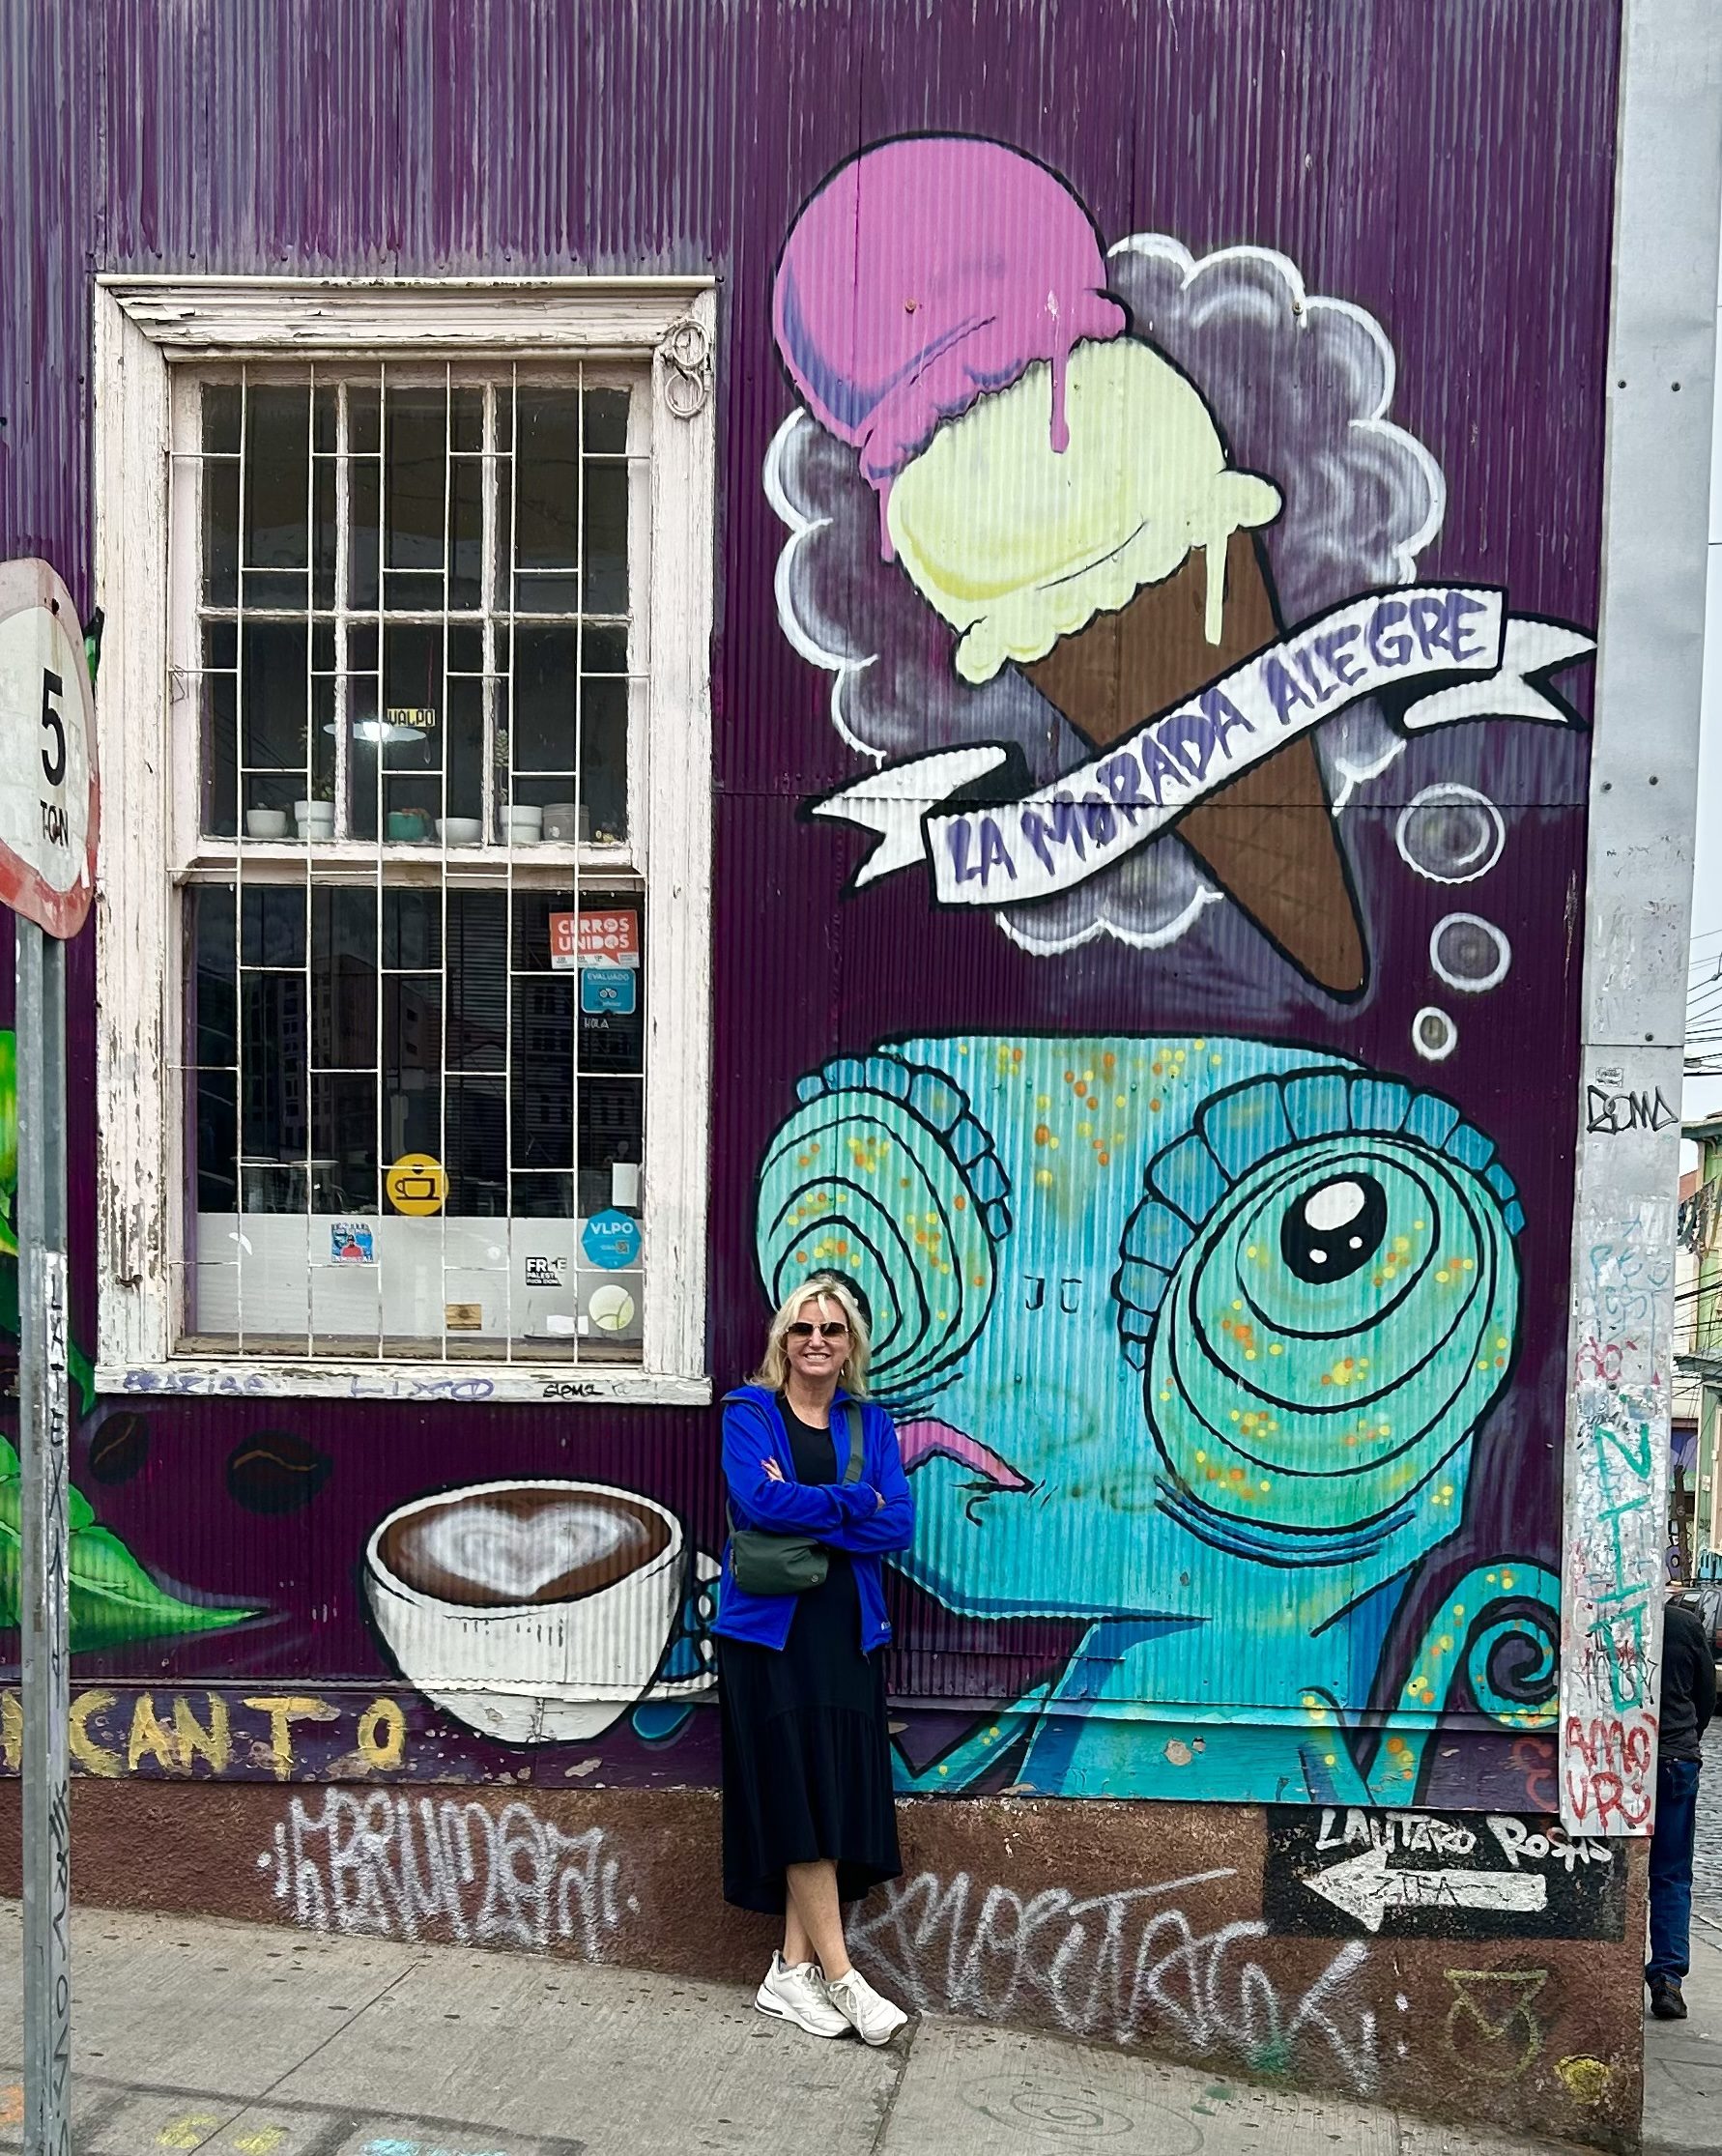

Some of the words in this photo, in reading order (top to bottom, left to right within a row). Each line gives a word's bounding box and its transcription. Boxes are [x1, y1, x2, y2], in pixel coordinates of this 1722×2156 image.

[42, 668, 66, 786] 5
[946, 819, 1016, 886] LA
[1020, 687, 1255, 877] MORADA
[1261, 590, 1489, 727] ALEGRE
[41, 799, 69, 848] TON
[588, 972, 629, 981] EVALUADO
[589, 1222, 634, 1235] VLPO
[527, 1258, 566, 1273] FRE
